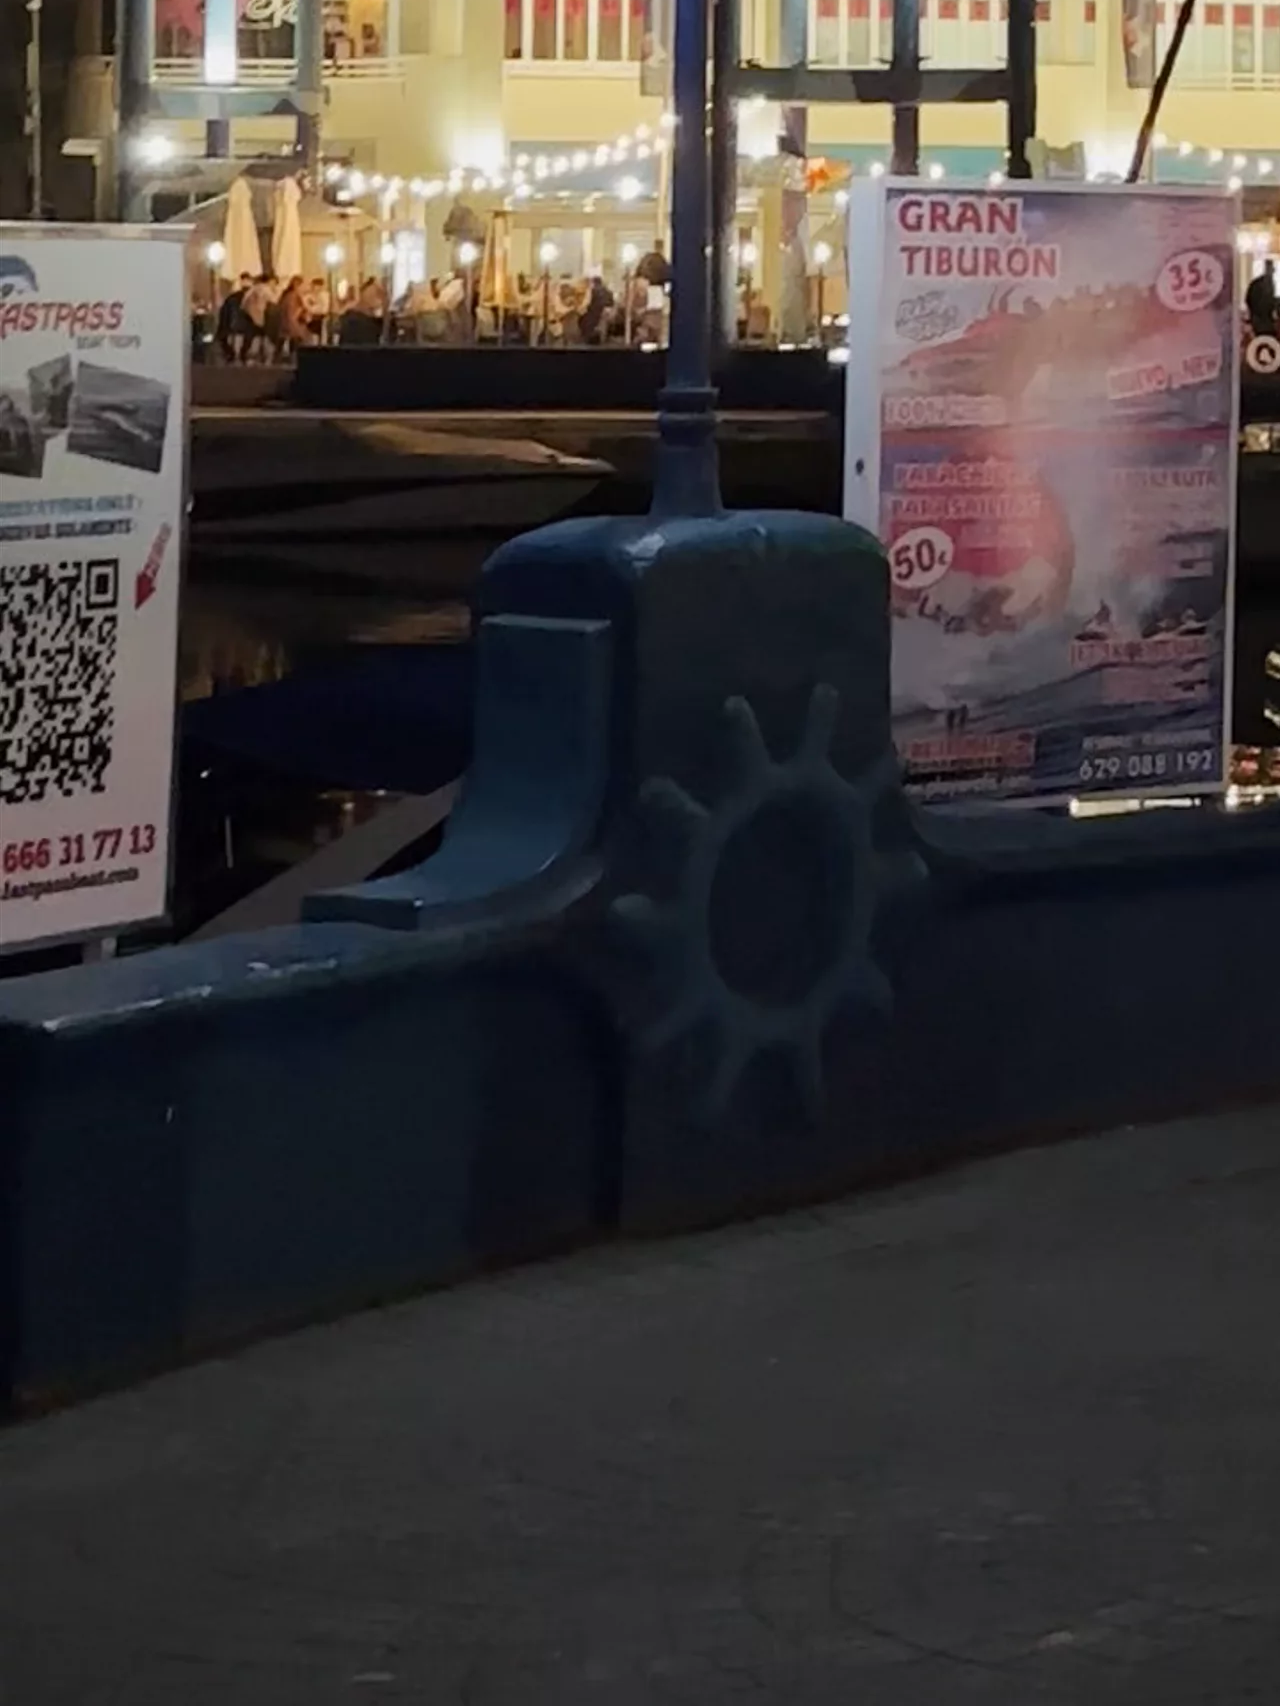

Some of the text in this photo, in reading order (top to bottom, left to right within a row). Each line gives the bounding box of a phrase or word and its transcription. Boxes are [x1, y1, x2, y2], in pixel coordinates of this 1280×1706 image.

[898, 200, 1018, 235] GRAN
[1079, 756, 1122, 781] 629
[1176, 748, 1214, 772] 192
[3, 823, 156, 874] 666 31 77 13
